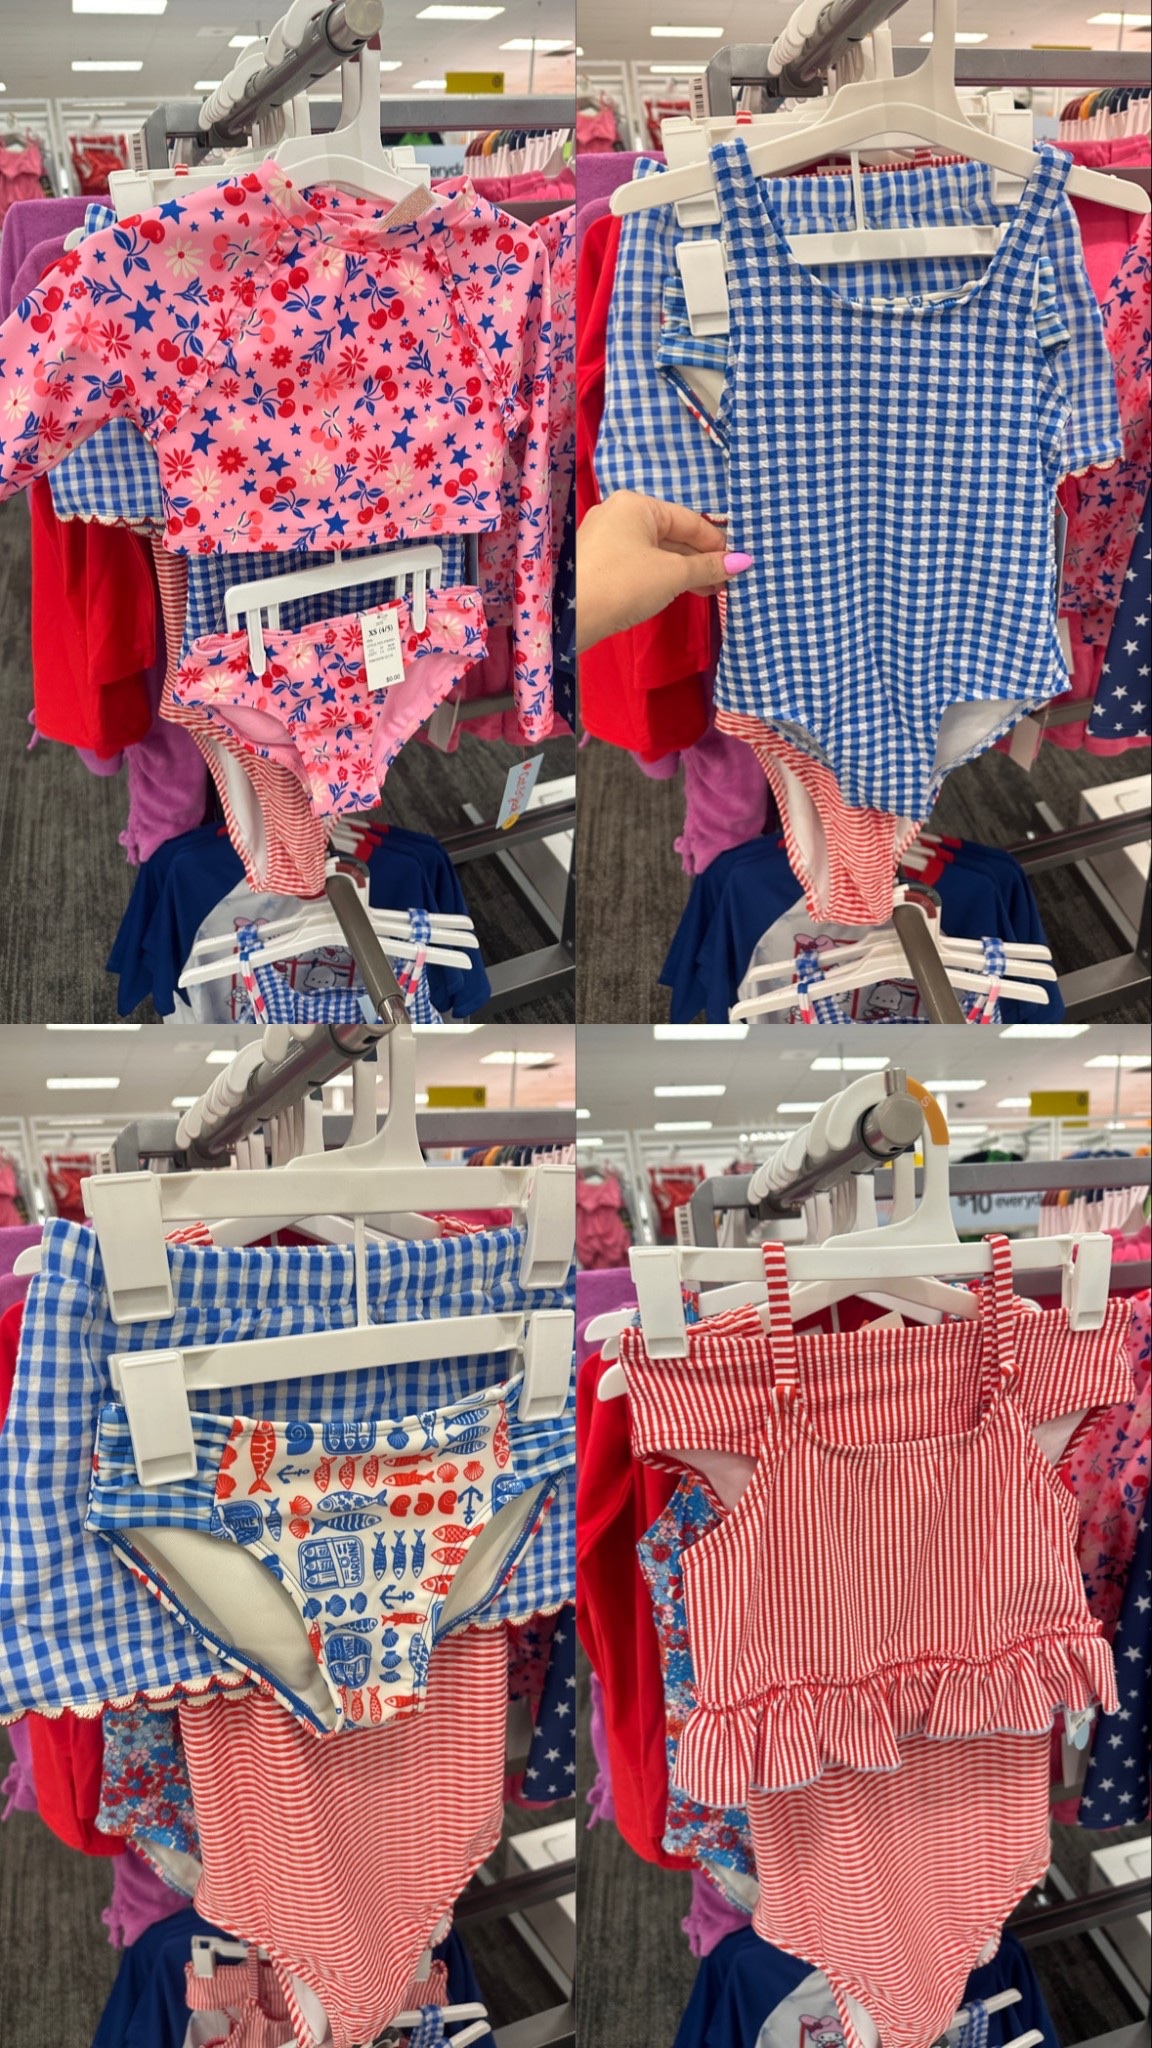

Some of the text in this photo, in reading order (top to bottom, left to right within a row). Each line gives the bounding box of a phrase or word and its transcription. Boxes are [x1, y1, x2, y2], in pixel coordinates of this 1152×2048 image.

[368, 629, 378, 637] XS
[957, 1194, 992, 1214] $10
[350, 1541, 361, 1582] SARDINE
